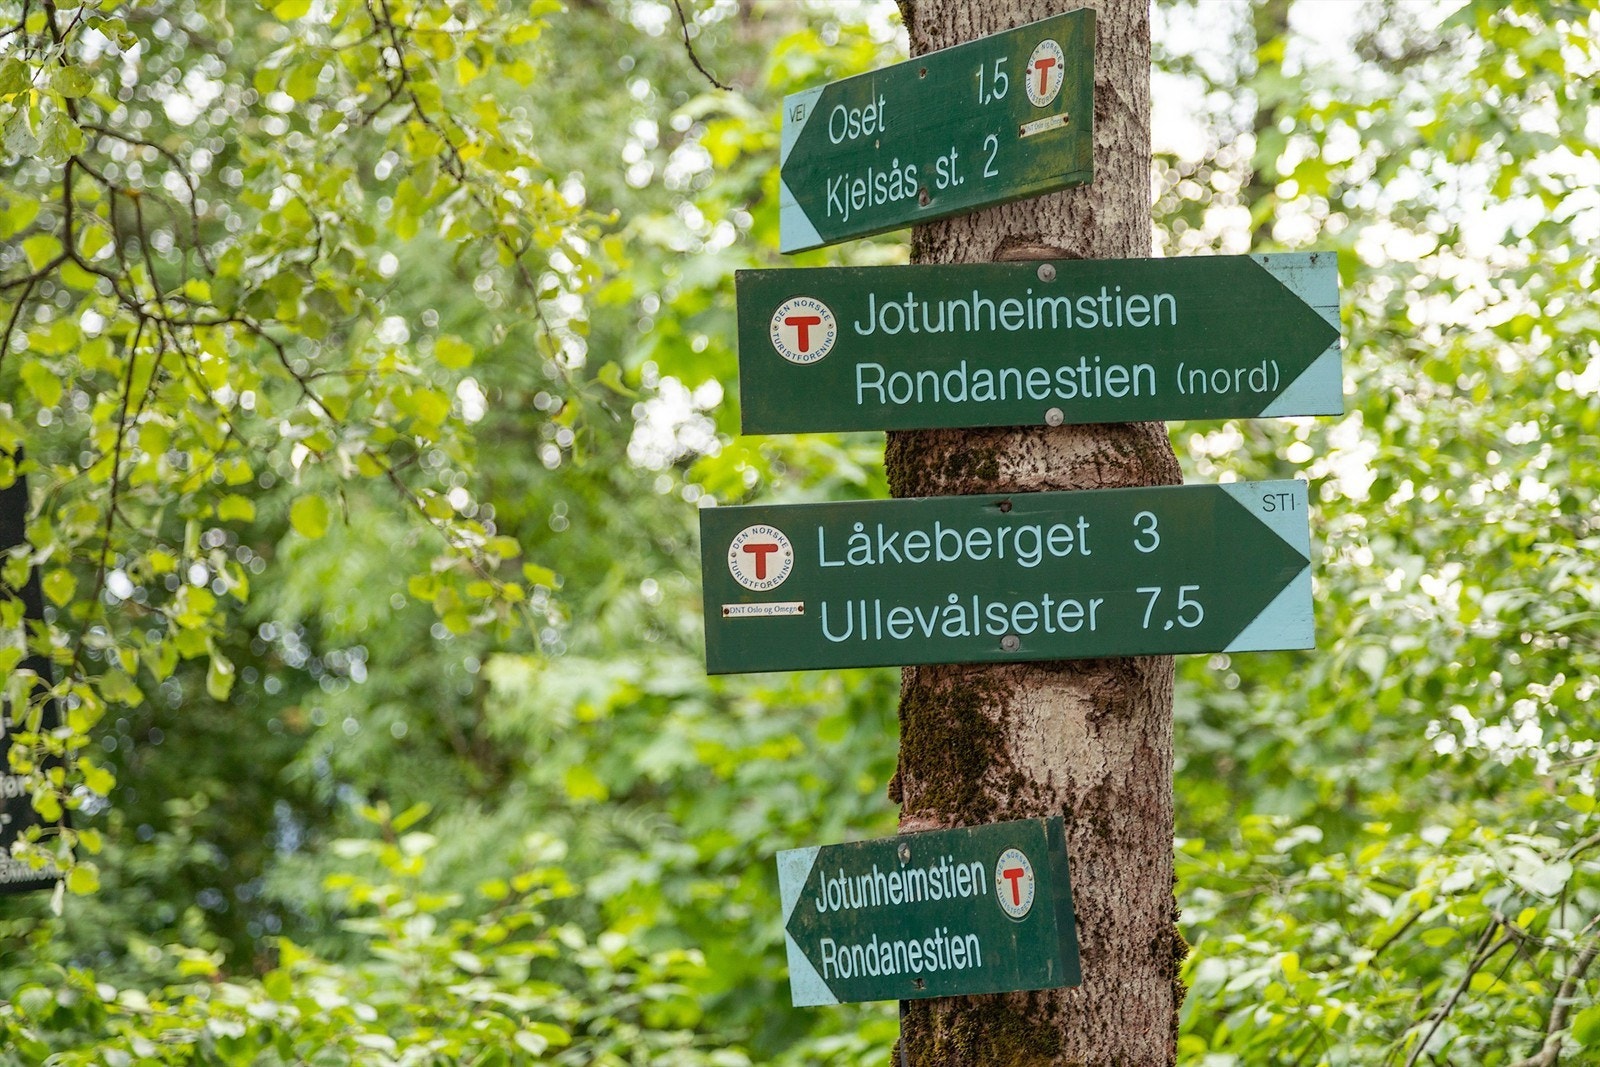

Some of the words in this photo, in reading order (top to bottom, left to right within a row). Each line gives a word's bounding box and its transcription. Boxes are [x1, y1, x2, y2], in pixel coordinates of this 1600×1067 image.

[1041, 42, 1062, 62] NORSKE
[1035, 58, 1056, 96] T
[789, 103, 806, 123] VEI
[828, 94, 887, 145] Oset
[976, 56, 1009, 105] 1,5
[827, 158, 918, 223] Kjelsås
[936, 146, 964, 190] st.
[983, 133, 999, 178] 2
[775, 304, 791, 323] DEN
[794, 300, 831, 321] NORSKE
[854, 286, 1177, 336] Jotunheimstien
[773, 331, 834, 361] TURISTFORENING
[784, 316, 821, 352] T
[856, 357, 1157, 405] Rondanestien
[1176, 360, 1280, 395] (nord)
[1262, 494, 1295, 513] STI
[733, 532, 749, 550] DEN
[752, 527, 789, 549] NORSKE
[818, 516, 1091, 569] Låkeberget
[1132, 511, 1160, 554] 3
[731, 558, 791, 589] TURISTFORENING
[743, 544, 779, 580] T
[729, 606, 745, 614] DNT
[747, 605, 763, 614] Oslo
[764, 607, 773, 615] og
[774, 605, 797, 615] Omegn
[820, 593, 1103, 643] Ullevålseter
[1136, 585, 1204, 632] 7,5
[815, 855, 987, 913] Jotunheimstien
[1003, 868, 1025, 906] T
[820, 927, 982, 980] Rondanestien
